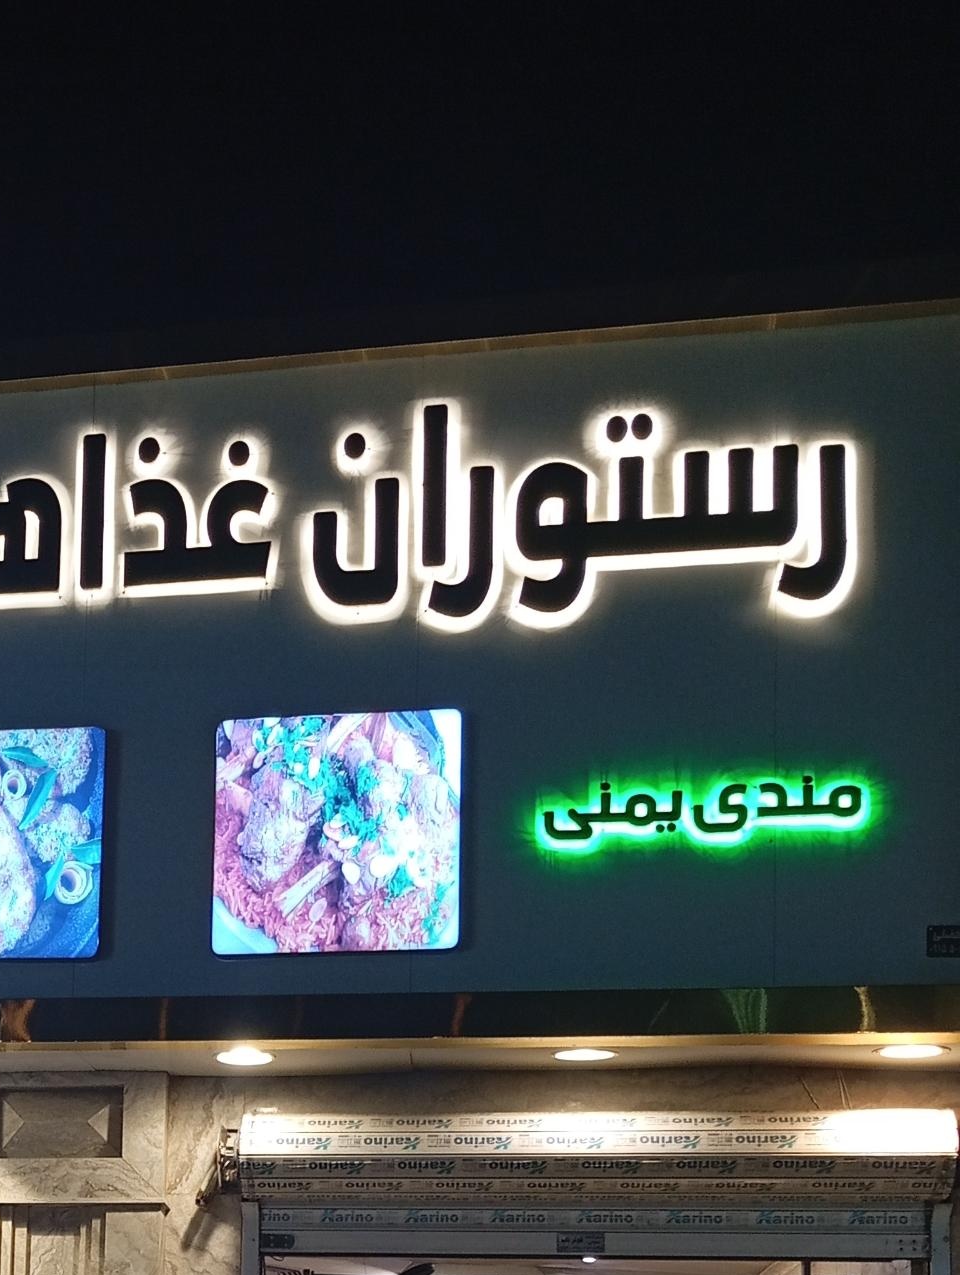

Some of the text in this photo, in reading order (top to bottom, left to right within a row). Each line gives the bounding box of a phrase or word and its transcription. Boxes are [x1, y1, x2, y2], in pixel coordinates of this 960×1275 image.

[312, 403, 846, 618] رستوران
[543, 775, 862, 840] مندی یمنی
